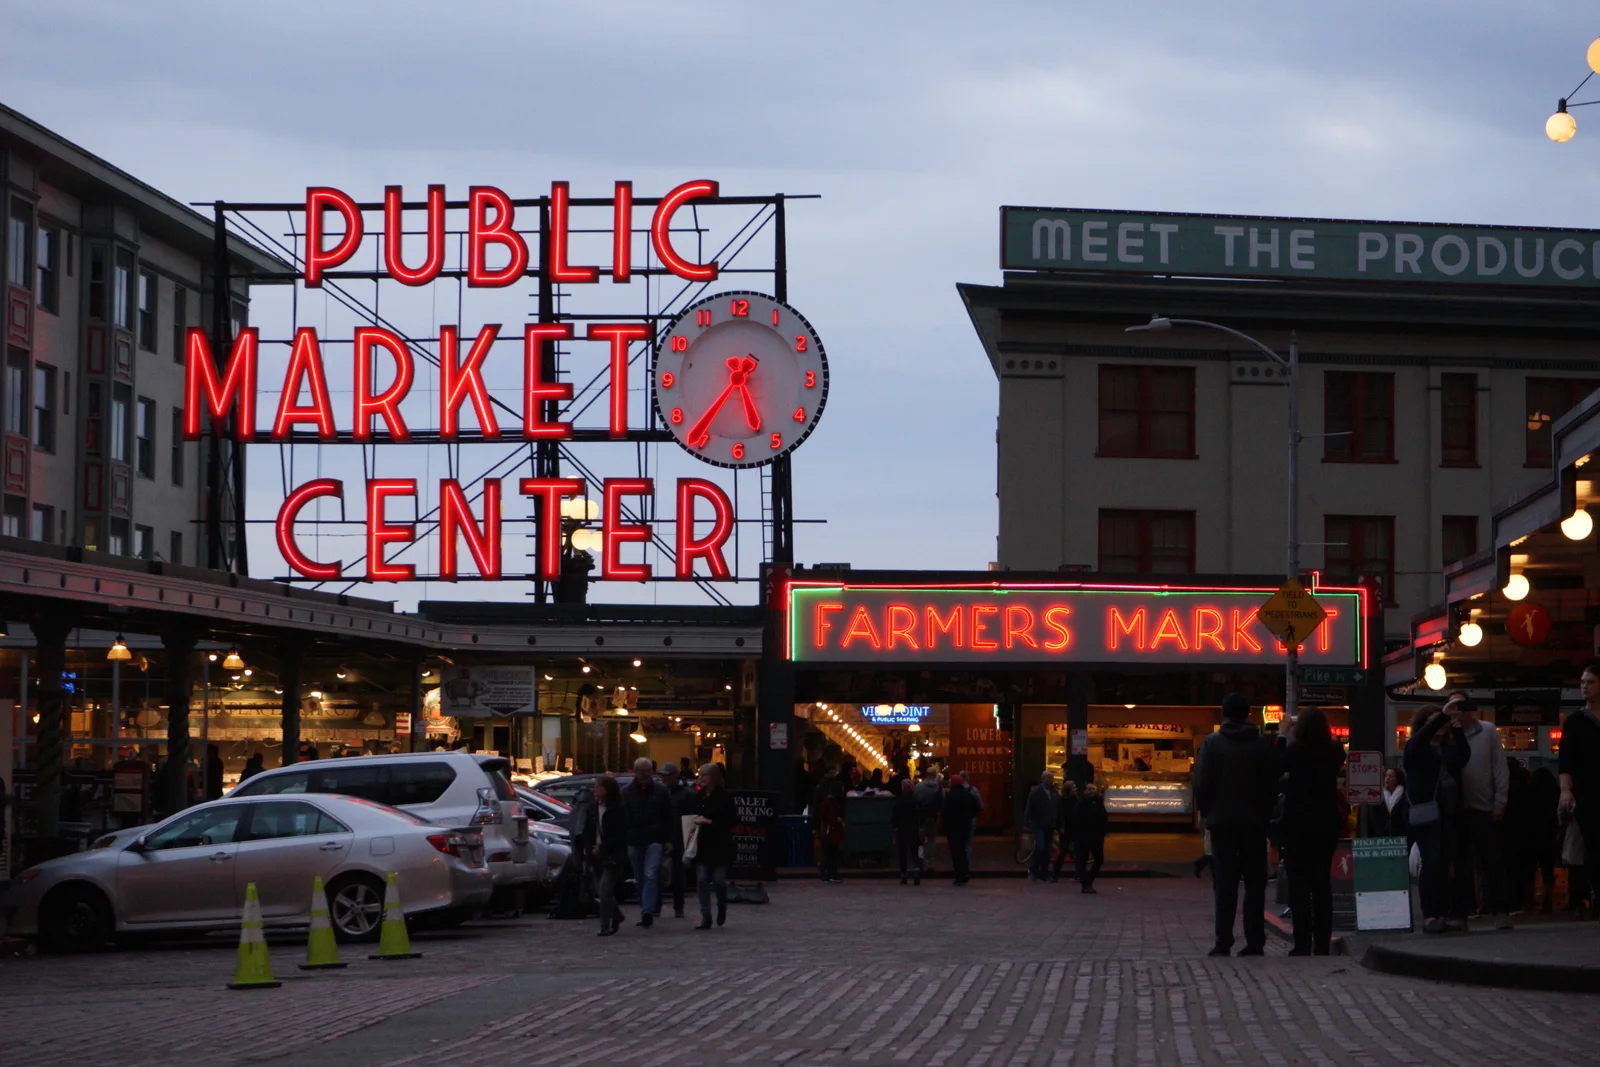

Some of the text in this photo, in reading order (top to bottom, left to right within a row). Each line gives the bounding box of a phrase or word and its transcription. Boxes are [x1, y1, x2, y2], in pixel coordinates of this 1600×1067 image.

[305, 179, 719, 288] PUBLIC
[1032, 218, 1600, 280] MEET THE PRODUC
[731, 299, 748, 317] 12
[697, 309, 711, 327] 11
[772, 309, 779, 326] 1
[671, 336, 688, 353] 10
[796, 335, 807, 352] 2
[184, 322, 655, 441] MARKET
[662, 371, 675, 389] 9
[804, 370, 816, 388] 3
[671, 407, 684, 424] 8
[792, 406, 806, 423] 4
[698, 431, 709, 449] 7
[770, 432, 782, 449] 5
[731, 442, 744, 460] 6
[276, 477, 735, 582] CENTER
[1288, 600, 1297, 609] TO
[1265, 610, 1318, 619] PEDESTRIANS
[816, 604, 1338, 651] FARMERS MARKT
[1304, 668, 1330, 682] Pike
[862, 705, 929, 717] VIPOINT
[967, 728, 1001, 741] LOWER
[965, 760, 1004, 774] LEVELS
[734, 797, 768, 806] VALET
[737, 806, 774, 816] RKING
[1381, 849, 1408, 857] GRILL
